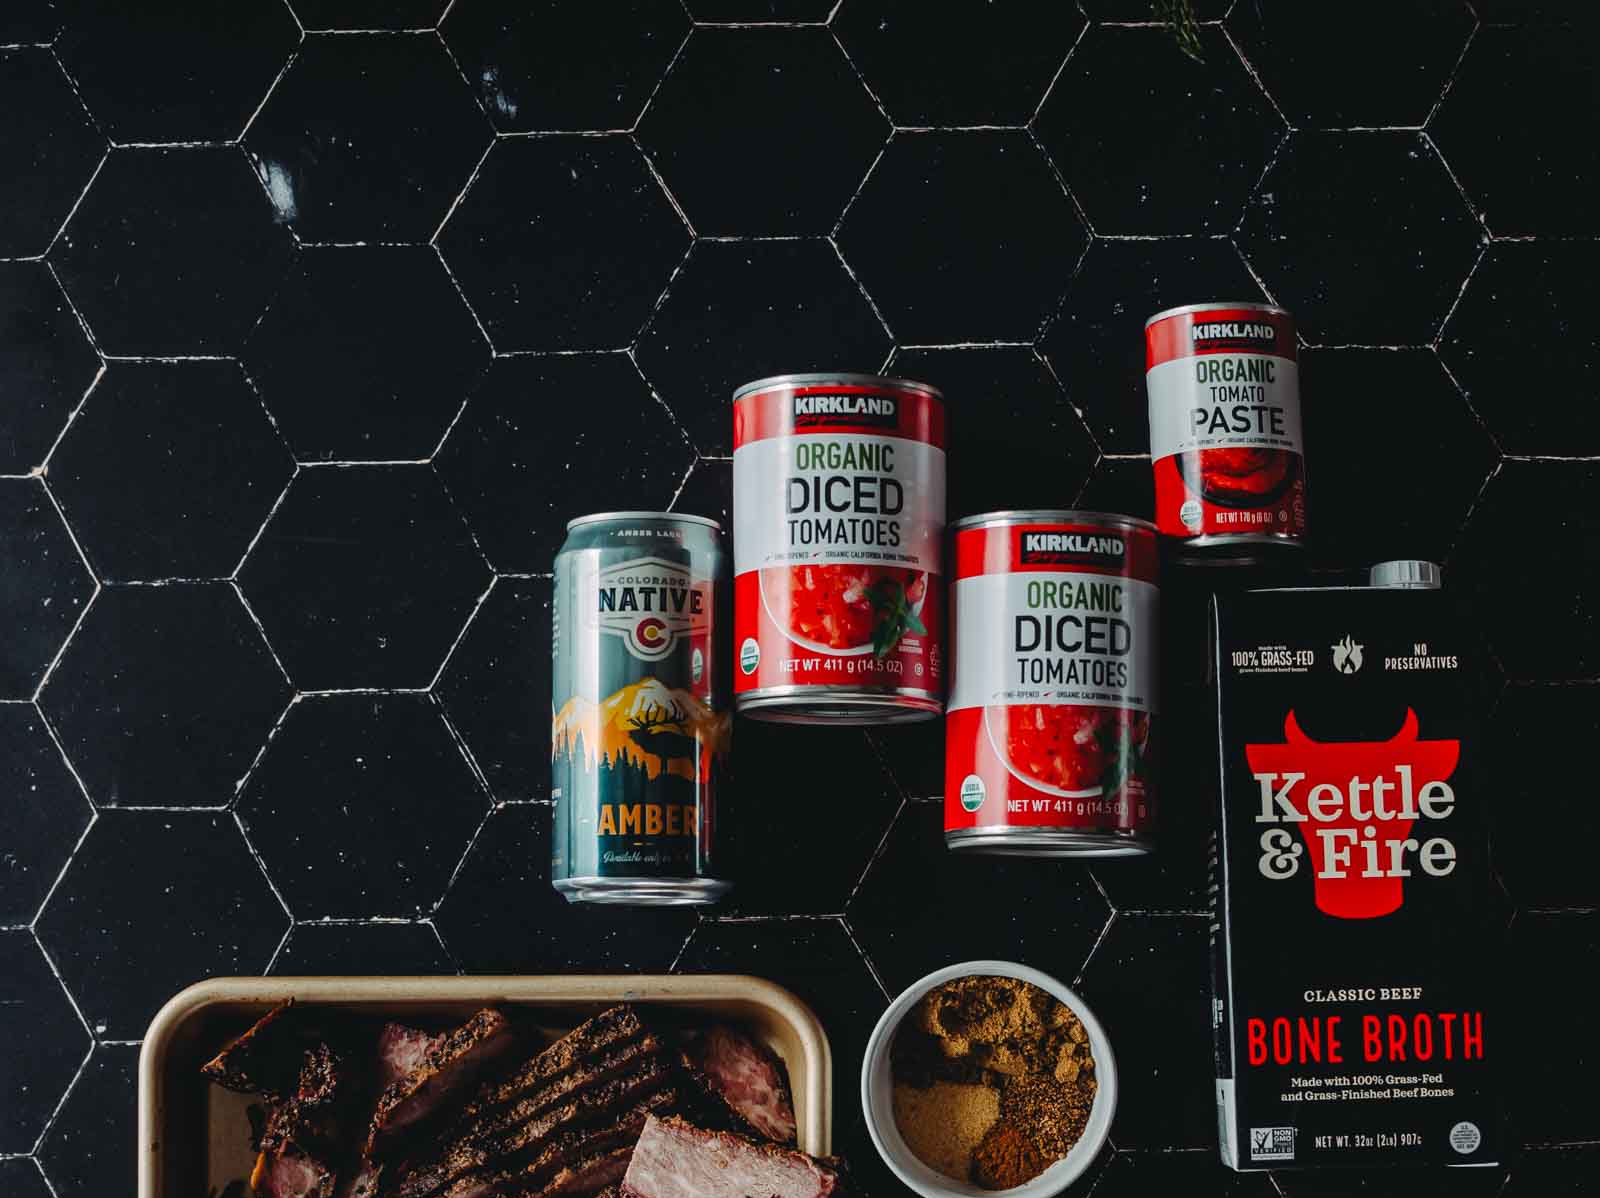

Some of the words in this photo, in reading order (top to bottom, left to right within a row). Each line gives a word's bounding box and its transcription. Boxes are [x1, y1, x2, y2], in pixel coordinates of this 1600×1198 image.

[1192, 323, 1275, 340] KIRKLAND
[1196, 359, 1275, 383] ORGANIC
[1211, 386, 1265, 402] TOMATO
[795, 397, 896, 416] KIRKLAND
[1192, 406, 1285, 435] PASTE
[797, 442, 895, 473] ORGANIC
[786, 476, 904, 515] DICED
[788, 519, 901, 547] TOMATOES
[1026, 534, 1124, 555] KIRKLAND
[618, 576, 686, 586] COLORADO
[599, 587, 704, 615] NATIVE
[1027, 581, 1123, 613] ORGANIC
[1015, 615, 1132, 657] DICED
[1231, 650, 1259, 667] 100%
[1261, 650, 1314, 667] GRASS-FED
[1414, 643, 1427, 656] NO
[780, 659, 801, 672] NET
[802, 659, 822, 672] WT
[824, 659, 843, 672] 411
[848, 662, 856, 675] g
[1017, 658, 1128, 688] TOMATOES
[1384, 656, 1458, 671] PRESERVATIVES
[1253, 764, 1456, 823] Kettle
[1008, 800, 1031, 813] NET
[1032, 800, 1052, 813] WT
[1054, 800, 1073, 813] 411
[1077, 803, 1084, 816] g
[598, 802, 698, 837] AMBER
[1258, 828, 1303, 880] &
[1315, 825, 1457, 880] Fire
[1303, 989, 1376, 1003] CLASSIC
[1379, 987, 1423, 1001] BEEF
[1247, 1015, 1344, 1066] BONE
[1362, 1011, 1484, 1063] BROTH
[1291, 1077, 1323, 1089] Made
[1324, 1075, 1351, 1088] with
[1352, 1075, 1384, 1087] 100%
[1385, 1073, 1444, 1086] Grass-Fed
[1281, 1091, 1303, 1102] and
[1304, 1088, 1391, 1102] Grass-Finished
[1392, 1087, 1420, 1099] Beef
[1420, 1086, 1455, 1099] Bones
[1315, 1135, 1332, 1149] NET
[1335, 1135, 1352, 1148] WT.
